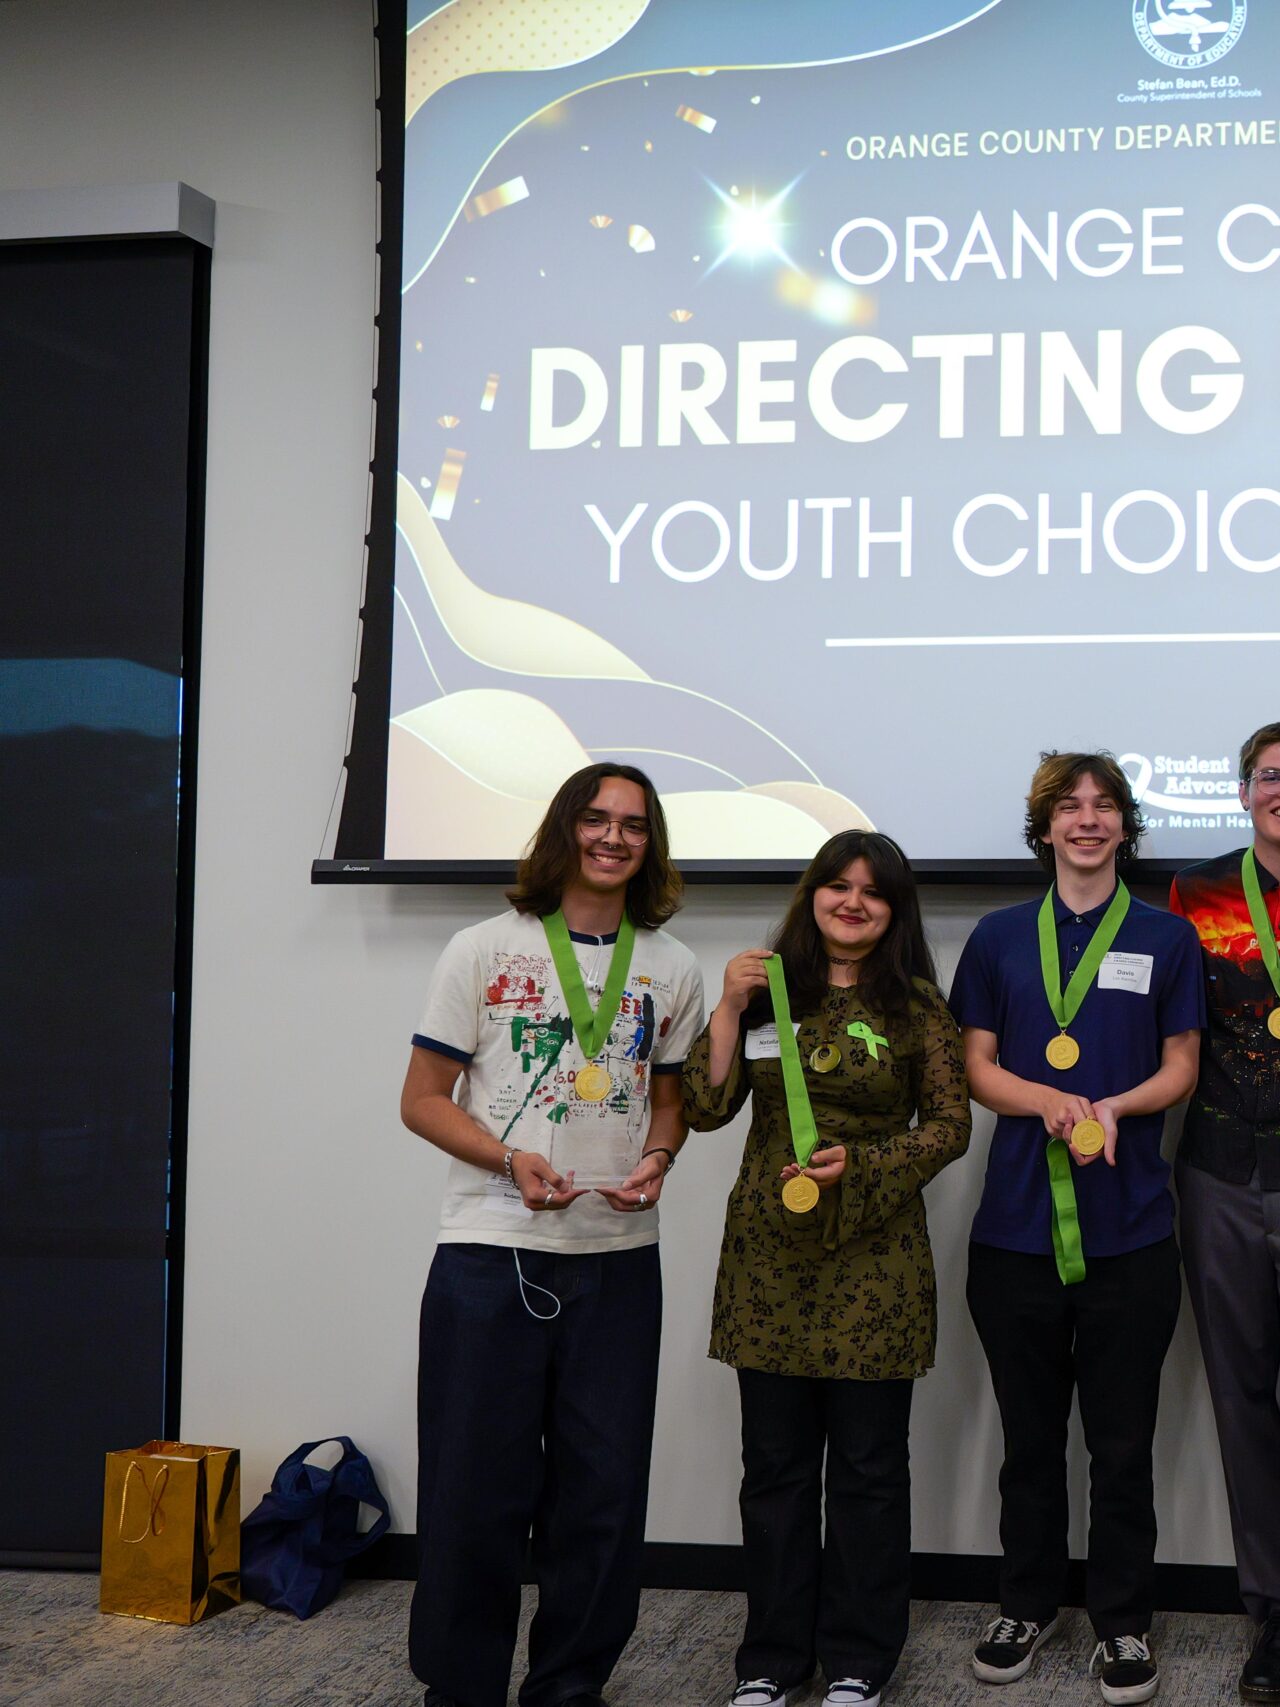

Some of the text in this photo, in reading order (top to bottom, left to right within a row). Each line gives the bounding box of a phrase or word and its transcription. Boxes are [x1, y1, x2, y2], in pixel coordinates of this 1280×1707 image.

[1135, 6, 1244, 66] DEPARTMENT OF EDUCATION
[1137, 75, 1241, 91] Stefan Bean, Ed.D.
[1117, 88, 1262, 103] County Superintendent of Schools
[846, 132, 969, 160] ORANGE
[979, 127, 1104, 155] COUNTY
[831, 207, 1184, 285] ORANGE
[529, 325, 1245, 450] DIRECTING
[584, 496, 913, 583] YOUTH
[1154, 755, 1230, 773] Student
[1164, 776, 1239, 794] Advoca
[1169, 815, 1220, 828] Mental
[1226, 815, 1253, 828] Hea
[1117, 969, 1135, 977] Davis
